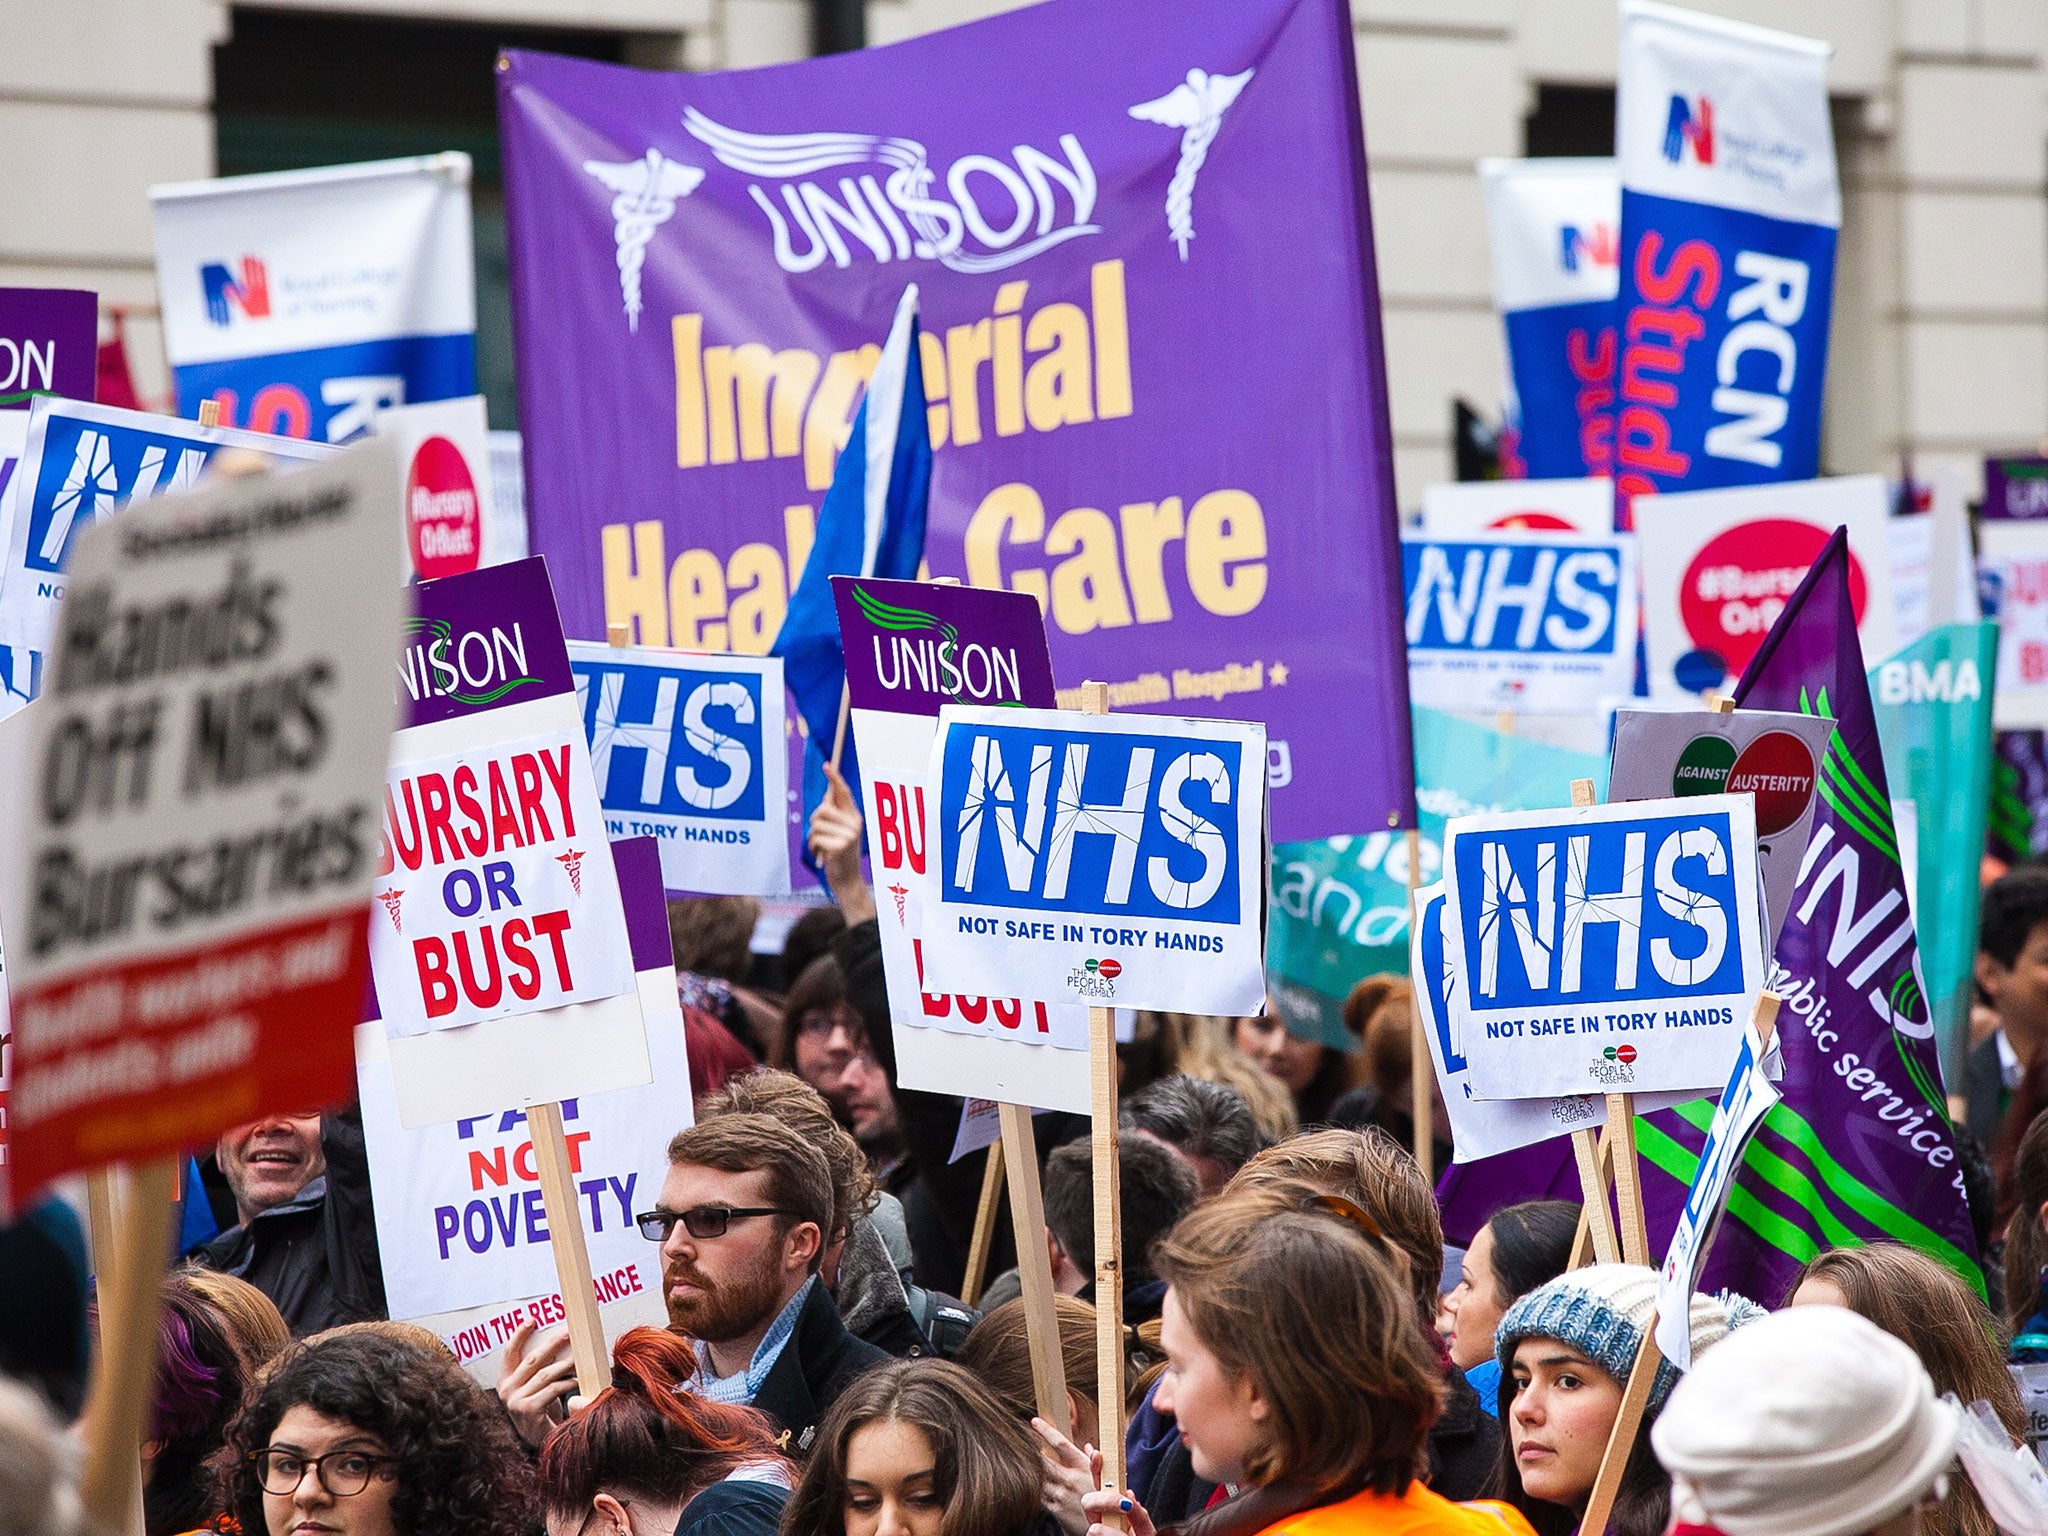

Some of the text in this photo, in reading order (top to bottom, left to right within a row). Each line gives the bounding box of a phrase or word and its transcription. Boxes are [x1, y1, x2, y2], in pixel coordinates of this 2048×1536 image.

[748, 133, 1099, 274] UNISON
[1703, 249, 1811, 468] RCN
[964, 482, 1268, 635] Care
[1406, 546, 1618, 651] NHS
[873, 635, 1022, 701] UNISON
[1878, 658, 1981, 705] BMA
[1678, 766, 1810, 792] AGAINST AUSTERITY
[630, 822, 677, 838] TORY
[685, 827, 751, 844] HANDS
[954, 736, 1231, 909] NHS
[442, 861, 522, 917] OR
[1479, 826, 1728, 997] NHS
[412, 910, 574, 1019] BUST
[958, 916, 1224, 953] NOT SAFE IN TORY HANDS
[1071, 967, 1088, 978] THE
[1078, 987, 1115, 998] ASSEMBLY
[1486, 1007, 1733, 1039] NOT SAFE IN TORY HANDS
[1592, 1058, 1607, 1067] THE
[1600, 1075, 1636, 1085] ASSEMBLY
[1775, 968, 1953, 1168] ublic service
[1561, 1108, 1595, 1125] ASSEMBLY
[468, 1131, 591, 1191] NOT
[434, 1172, 638, 1260] POVETY
[453, 1264, 643, 1362] JOIN THE RESANCE
